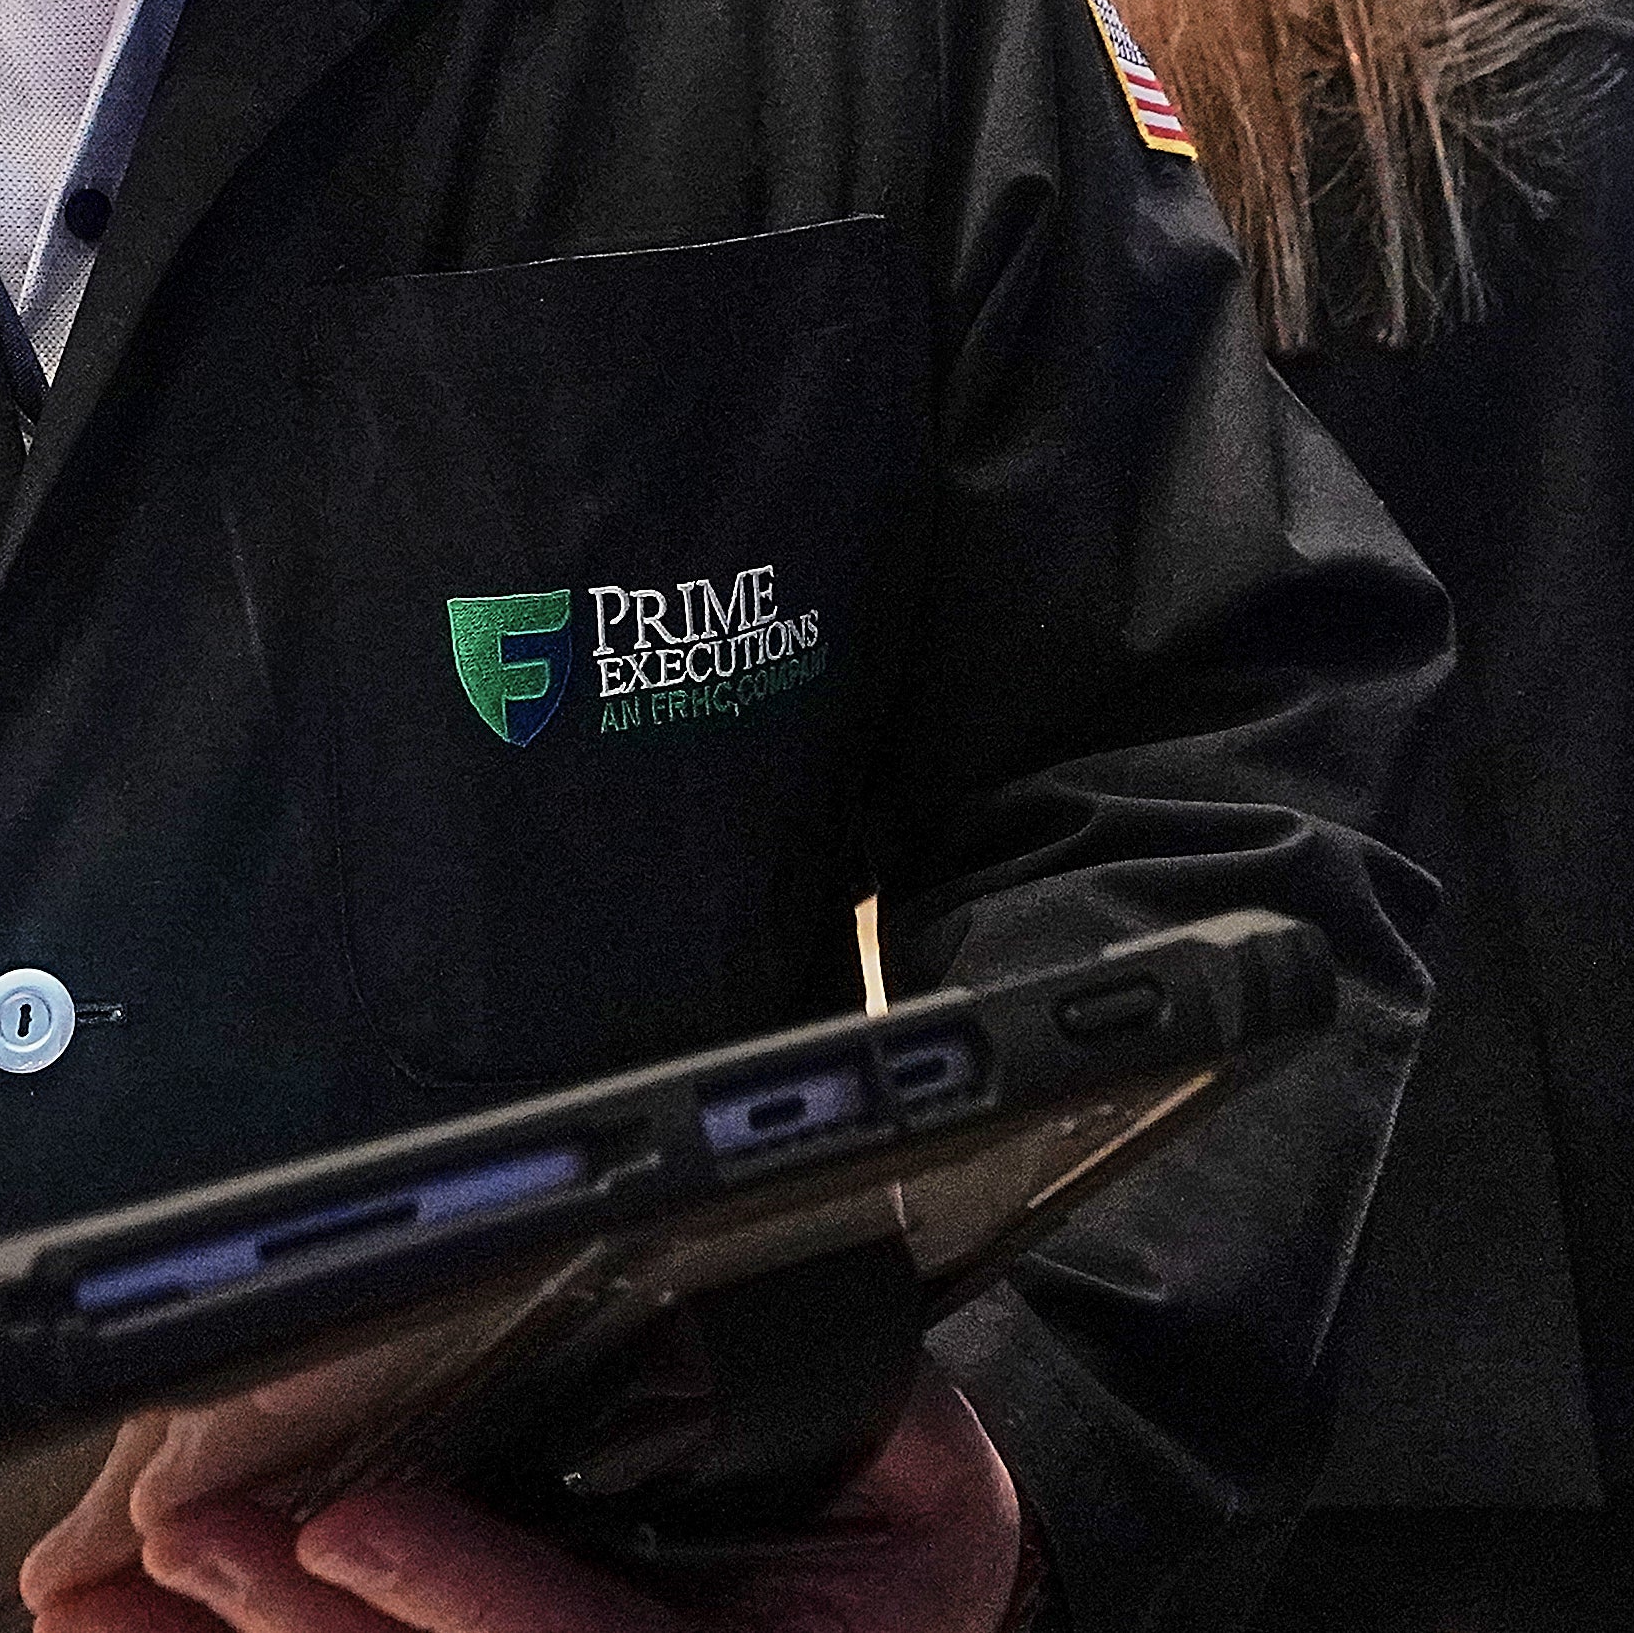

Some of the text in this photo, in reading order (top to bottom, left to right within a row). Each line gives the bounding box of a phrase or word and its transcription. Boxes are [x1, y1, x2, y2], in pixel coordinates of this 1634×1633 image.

[588, 565, 778, 656] PRIME
[598, 609, 820, 697] EXECUTIONS
[600, 697, 641, 734] AN
